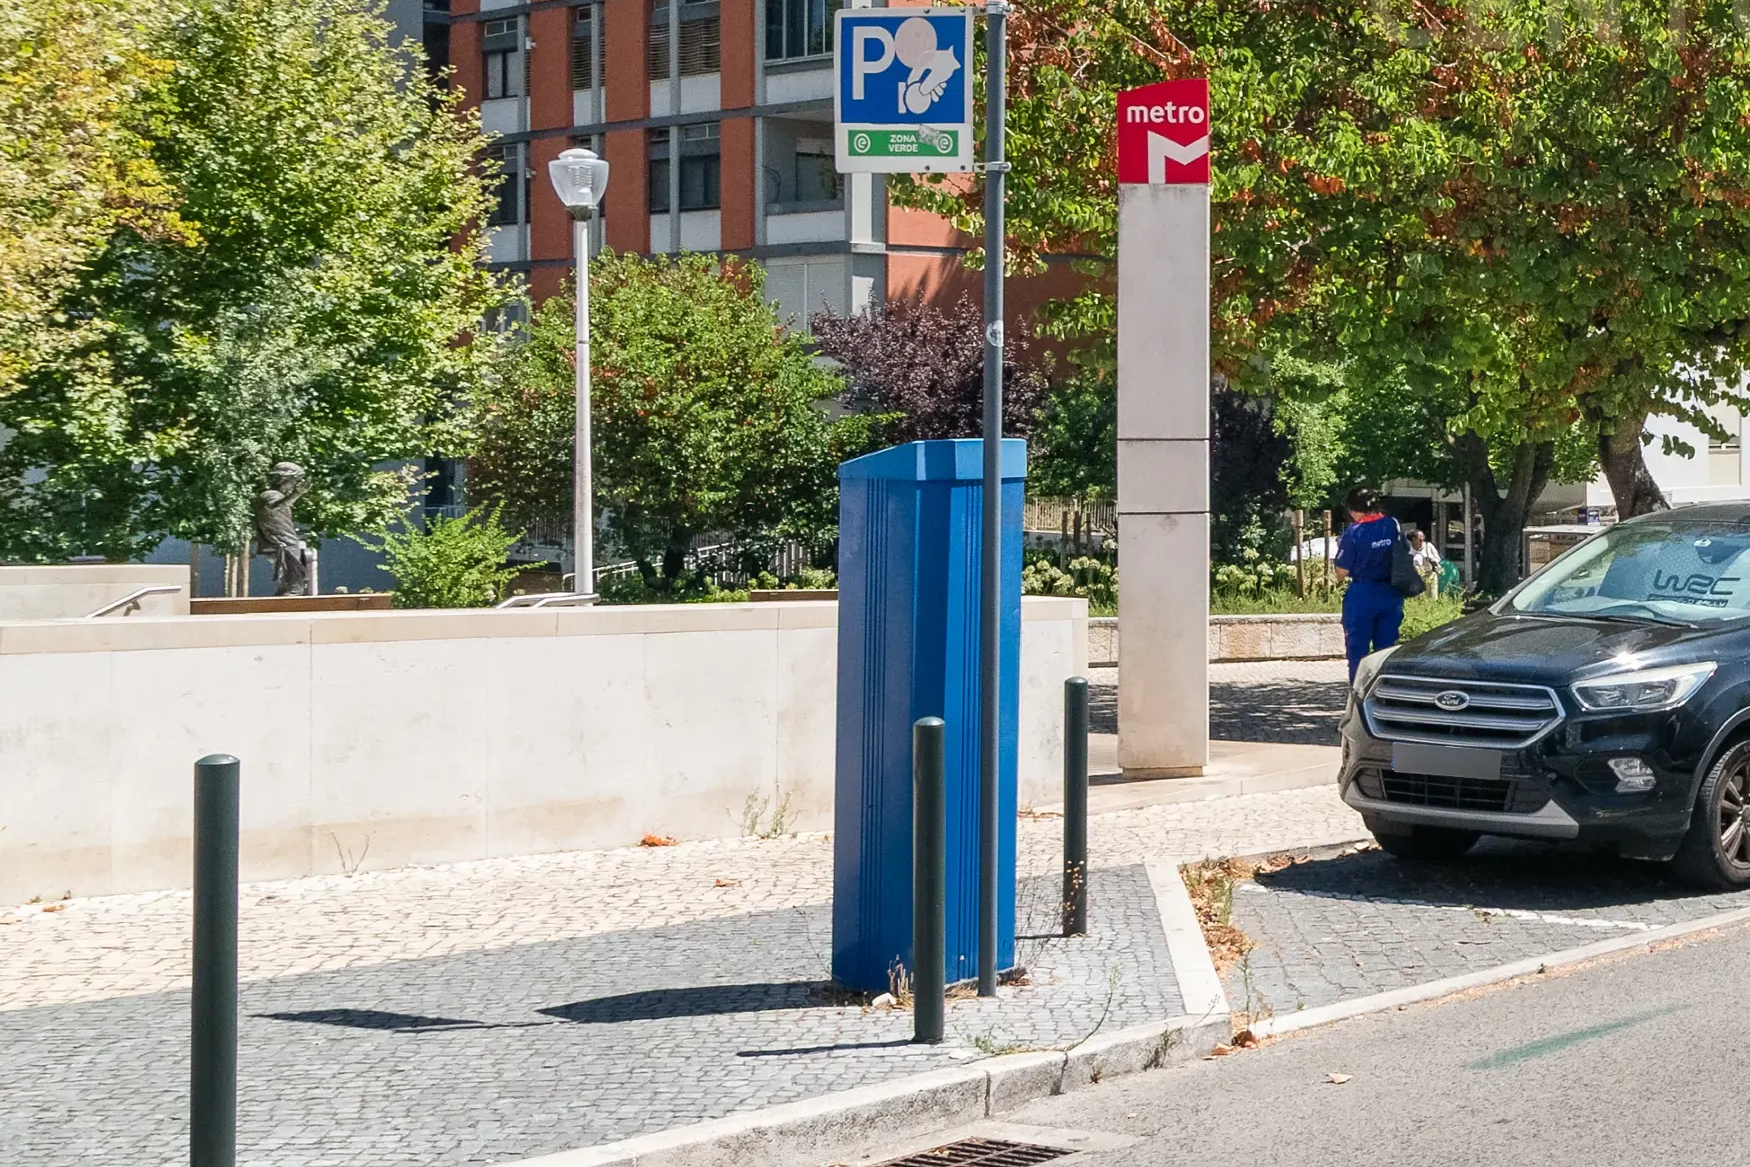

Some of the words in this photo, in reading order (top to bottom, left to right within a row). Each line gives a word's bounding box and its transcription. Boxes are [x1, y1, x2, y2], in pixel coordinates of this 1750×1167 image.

[852, 26, 896, 100] P
[1126, 101, 1205, 124] metro
[889, 134, 917, 143] ZONA
[888, 143, 919, 152] VERDE
[1371, 538, 1392, 549] metro
